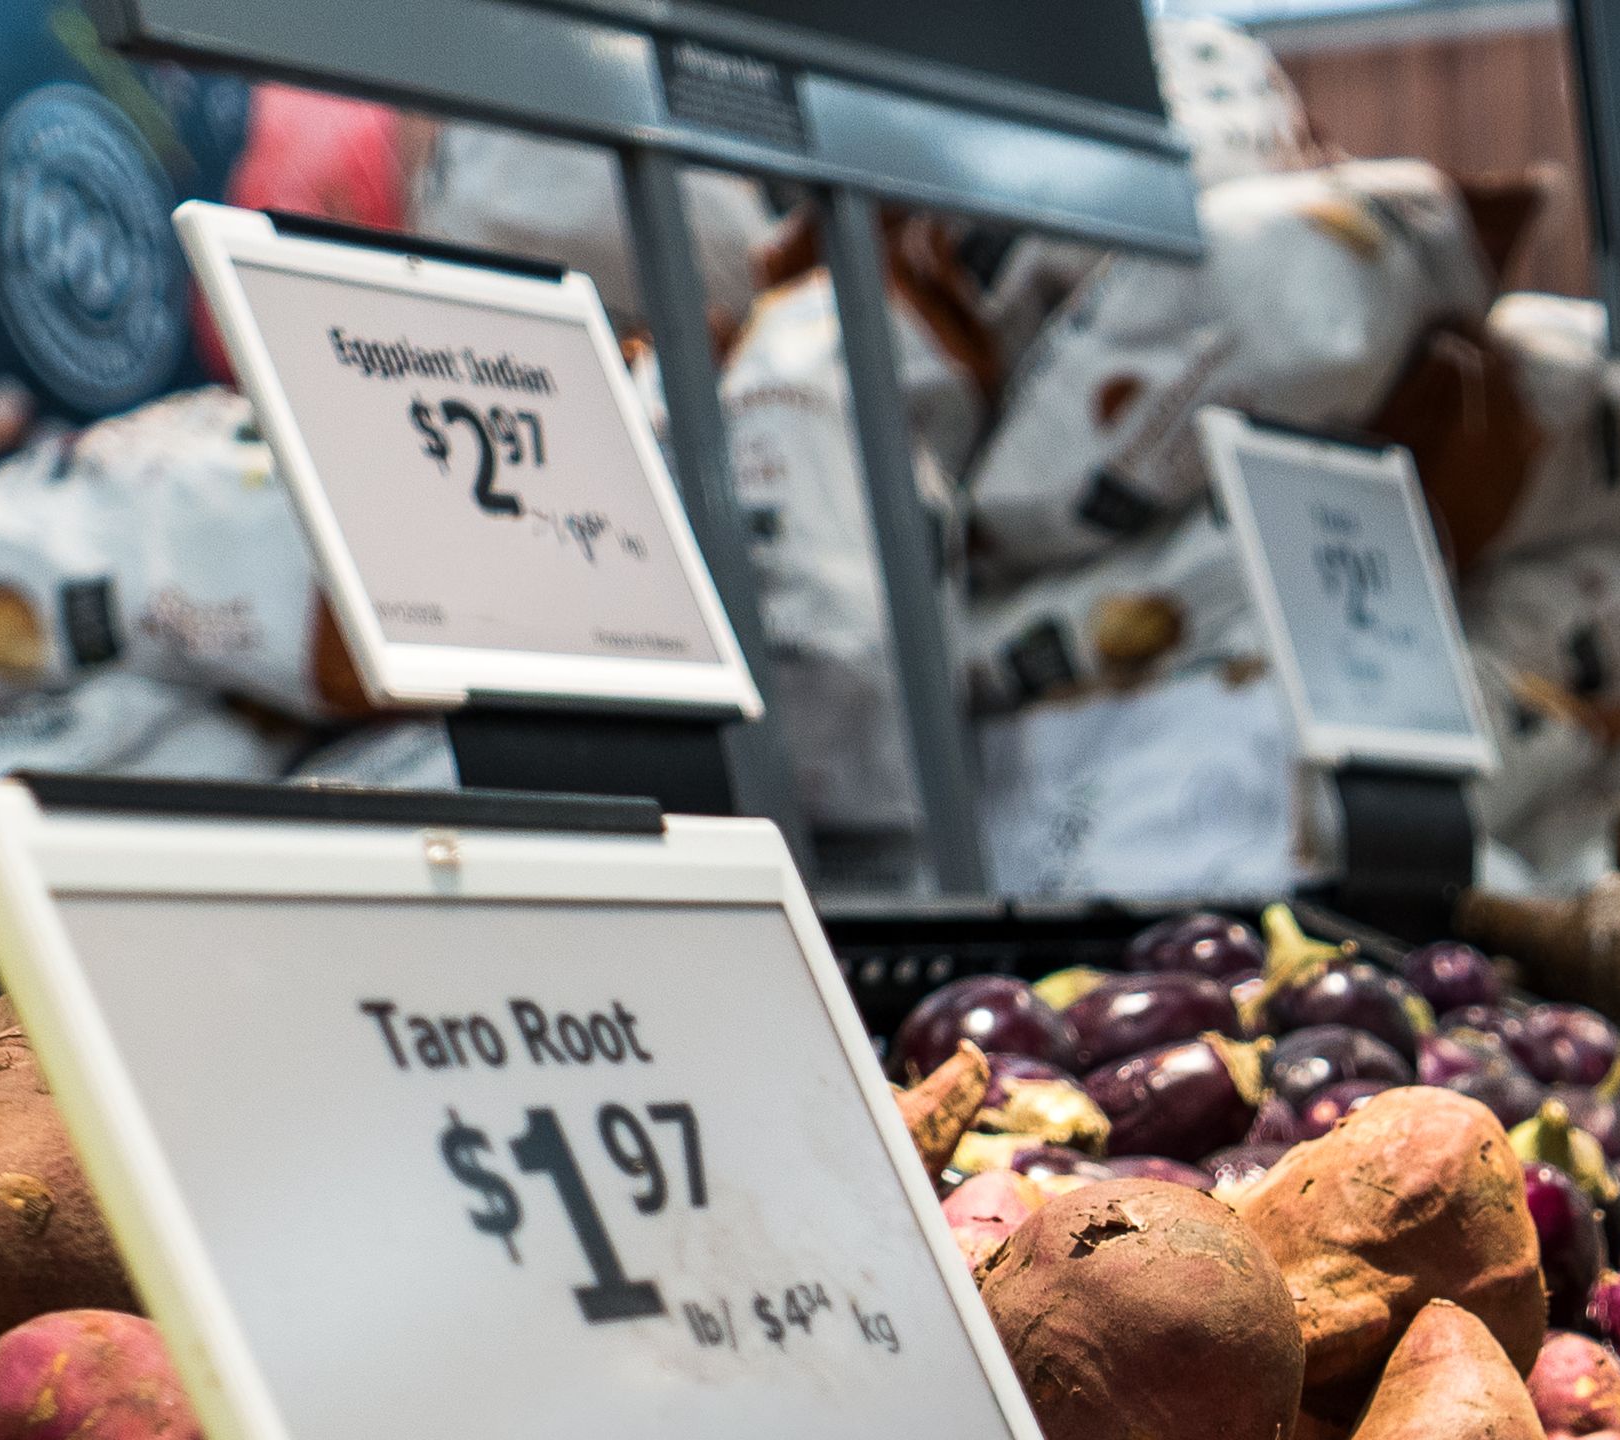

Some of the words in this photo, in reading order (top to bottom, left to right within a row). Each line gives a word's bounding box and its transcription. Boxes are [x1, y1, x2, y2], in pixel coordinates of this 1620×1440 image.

[359, 998, 509, 1070] Taro
[506, 998, 654, 1068] Root
[848, 1298, 901, 1355] kg
